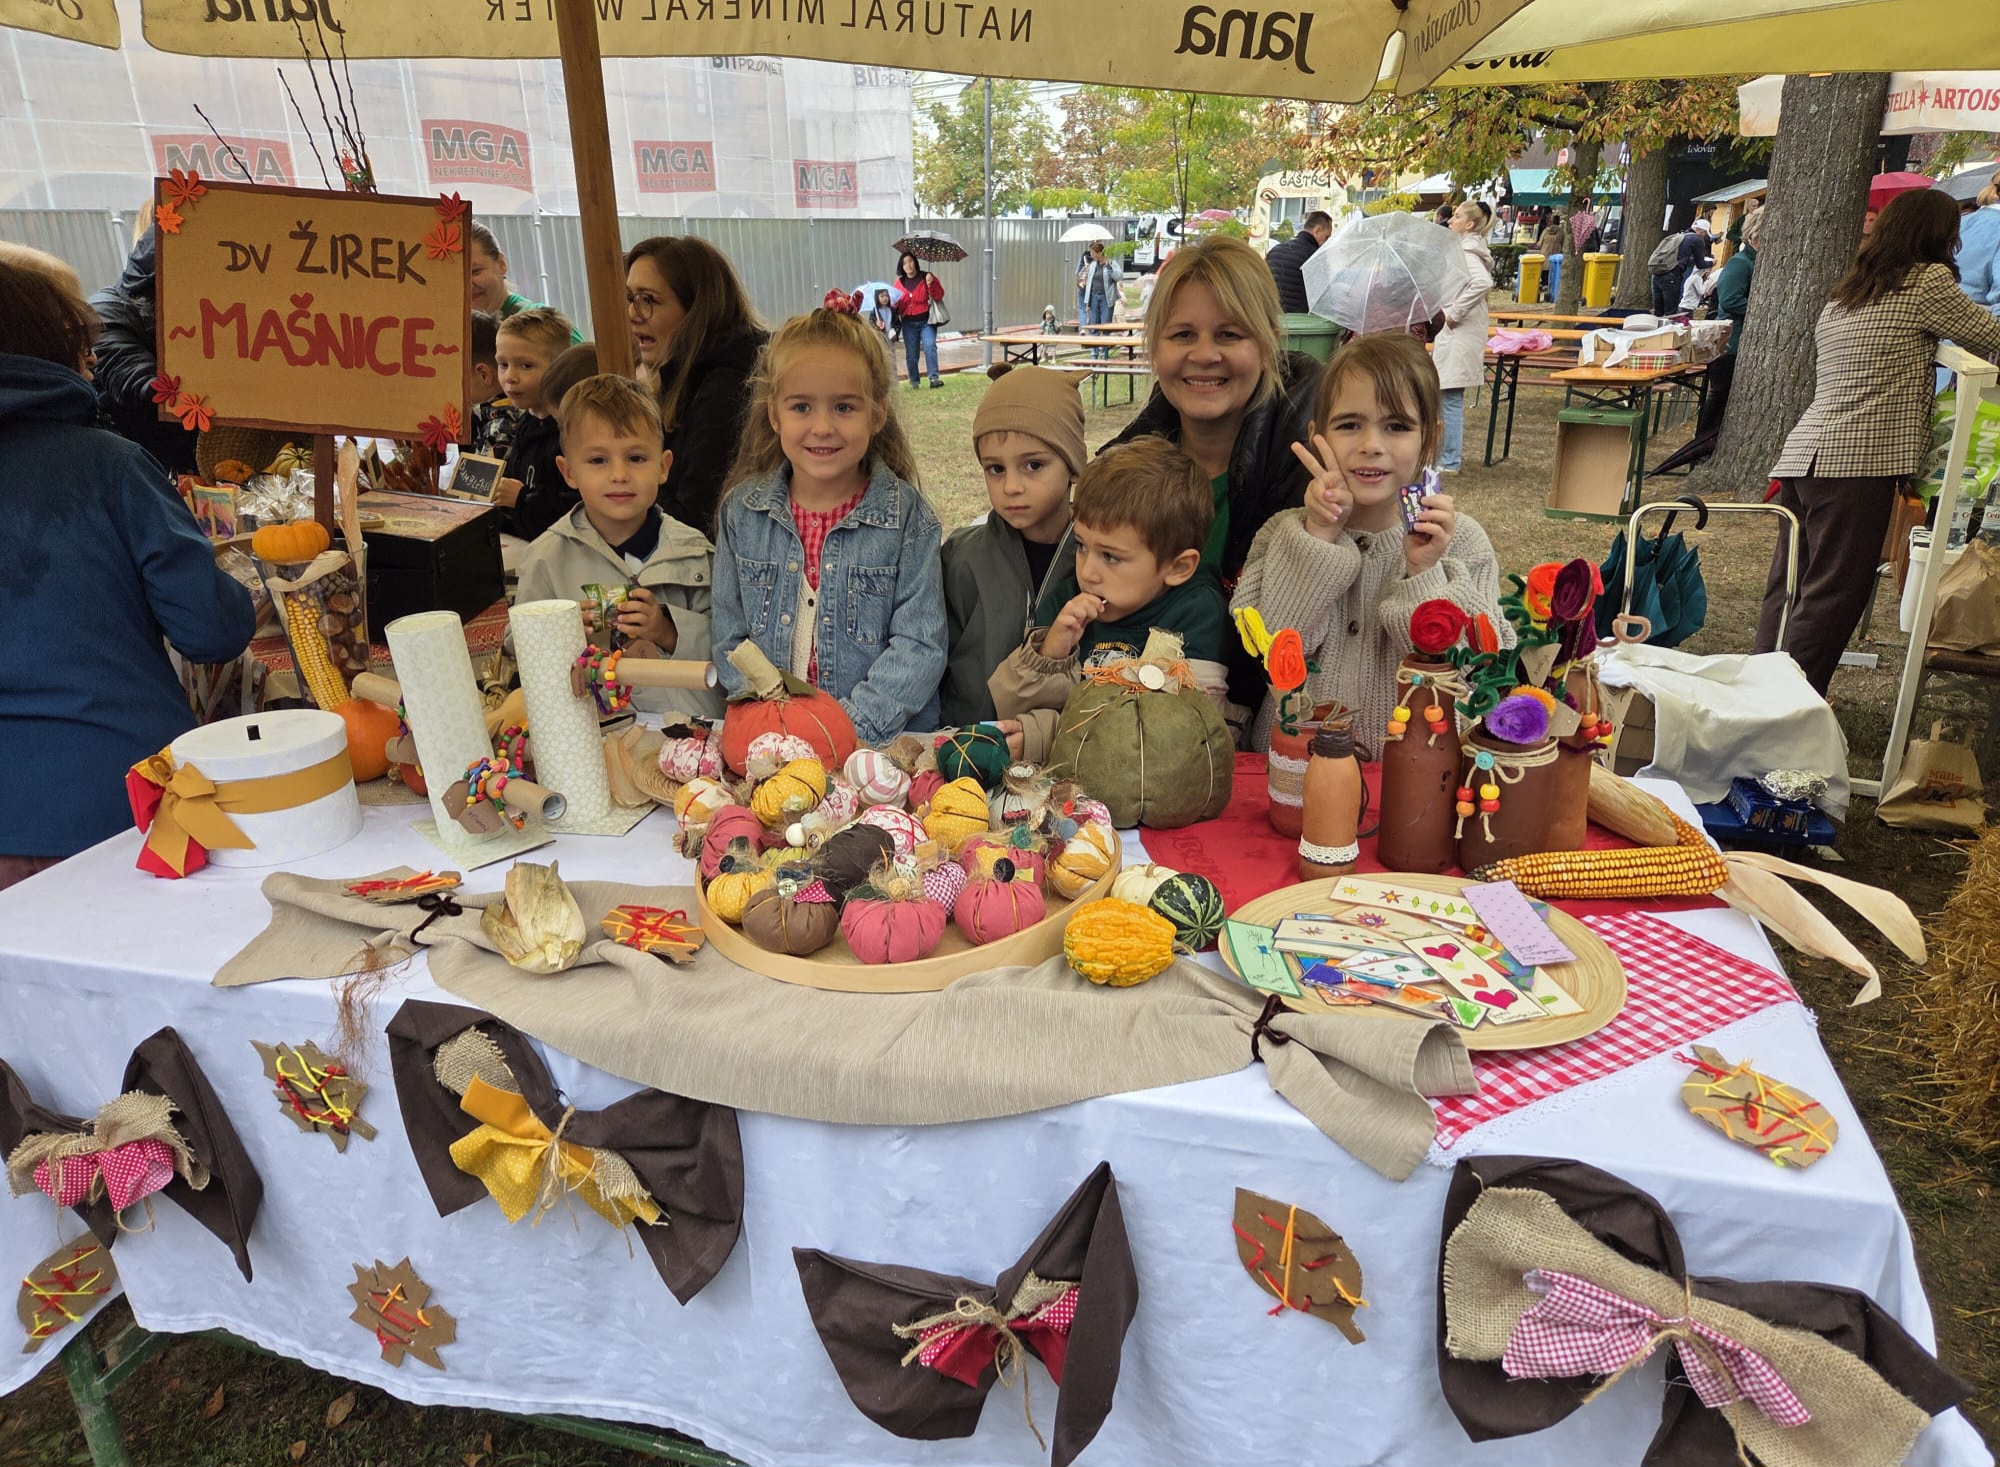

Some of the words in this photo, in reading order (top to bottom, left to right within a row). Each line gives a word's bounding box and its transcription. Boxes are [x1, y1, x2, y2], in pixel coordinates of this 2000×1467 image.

[1931, 86, 2000, 111] ARTOIS
[165, 143, 289, 185] MGA
[431, 127, 526, 169] MGA
[640, 147, 711, 174] MGA
[799, 165, 854, 192] MGA
[217, 240, 272, 274] DV
[289, 219, 428, 286] ŽIREK
[200, 292, 436, 378] MAŠNICE
